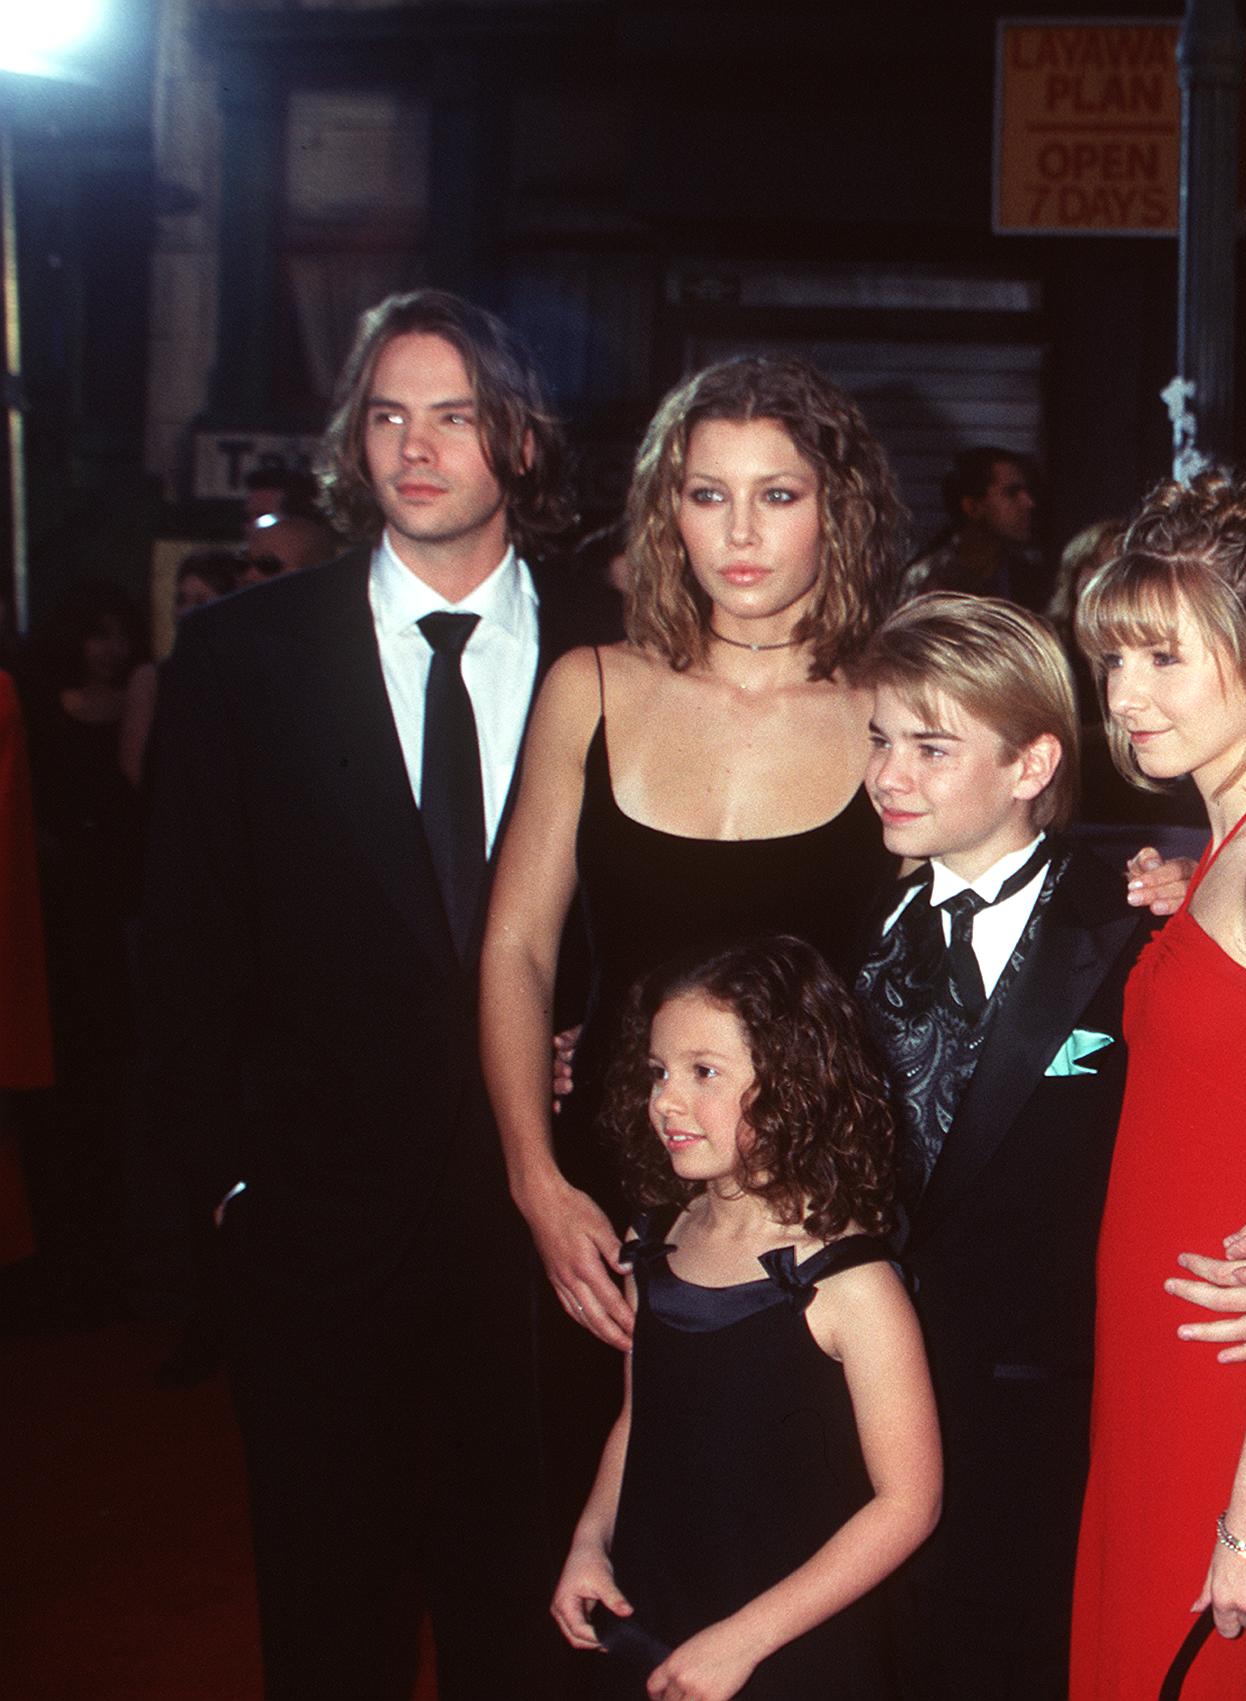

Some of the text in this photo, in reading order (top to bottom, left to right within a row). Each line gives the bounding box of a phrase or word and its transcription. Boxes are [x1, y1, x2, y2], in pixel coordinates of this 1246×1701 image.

[1010, 29, 1178, 70] LAYAWA
[1045, 74, 1164, 112] PLAN
[1037, 143, 1160, 182] OPEN
[1024, 186, 1169, 226] 7 DAYS
